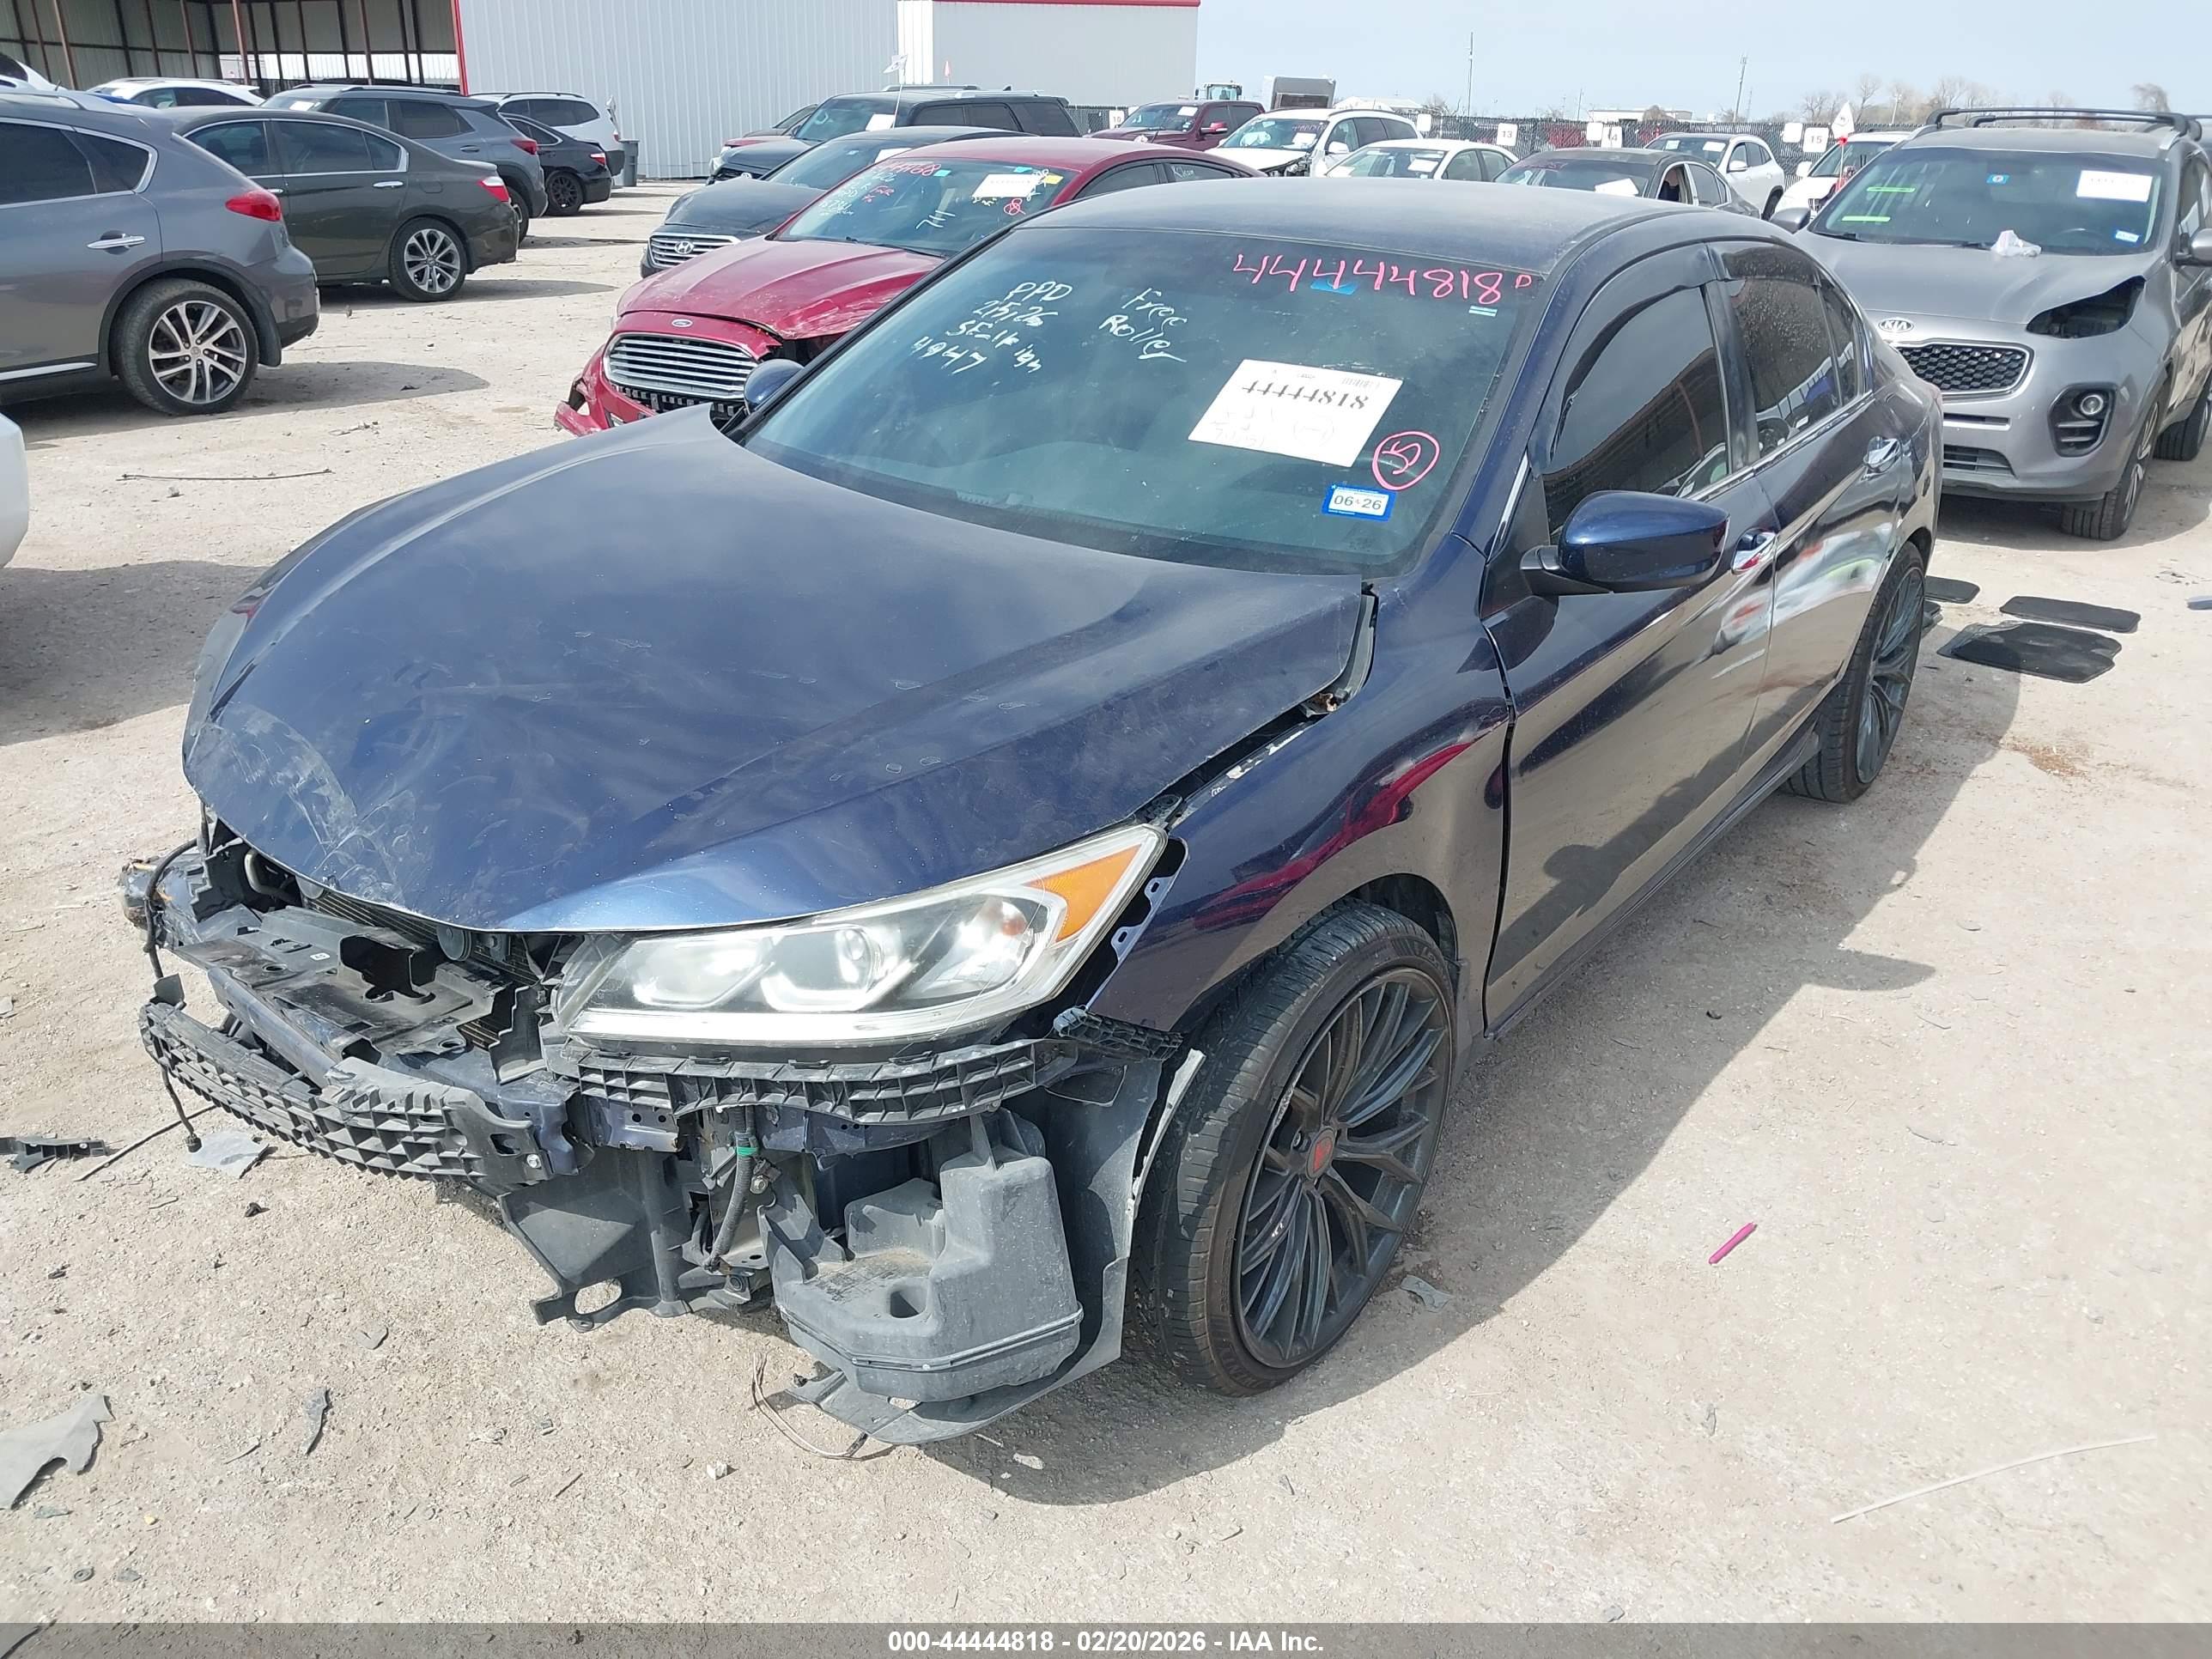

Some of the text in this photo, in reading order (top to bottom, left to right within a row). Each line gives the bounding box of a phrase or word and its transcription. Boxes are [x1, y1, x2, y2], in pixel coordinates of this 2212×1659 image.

[1811, 135, 1822, 144] 15
[1233, 253, 1504, 305] 44444818
[1003, 281, 1073, 302] PPD
[1883, 319, 1909, 331] KIA
[1242, 379, 1370, 410] 44444818
[1334, 495, 1383, 510] 06 26
